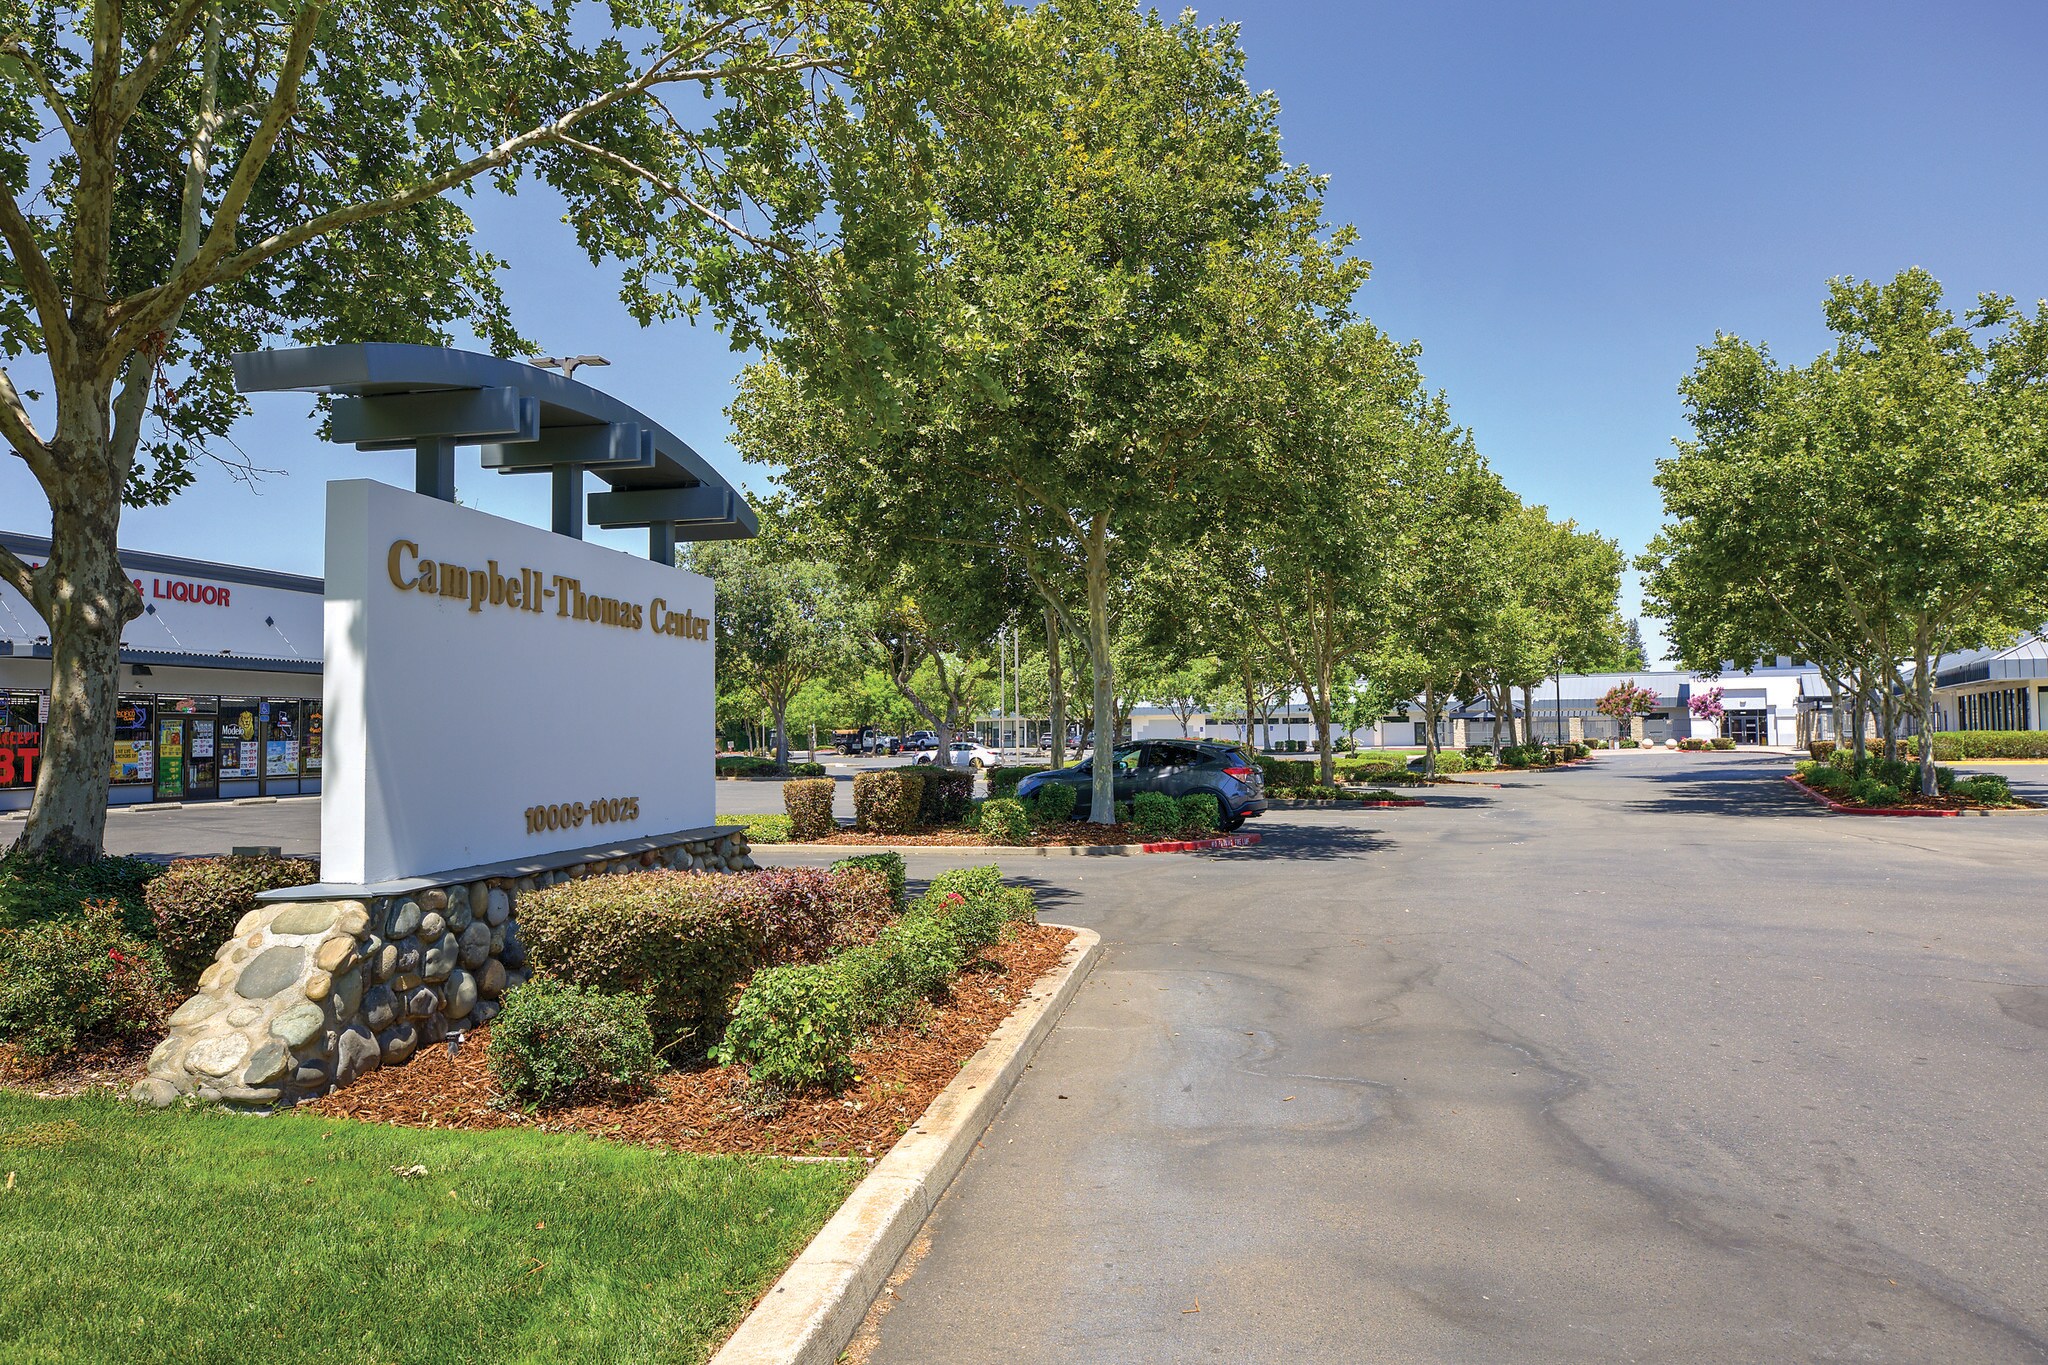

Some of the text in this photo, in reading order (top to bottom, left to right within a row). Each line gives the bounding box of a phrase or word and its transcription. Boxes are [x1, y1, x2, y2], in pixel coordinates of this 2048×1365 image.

[153, 578, 231, 607] LIQUOR
[388, 539, 711, 641] Campbell-Thomas Center
[0, 732, 39, 745] CCEPT
[222, 725, 245, 736] Modelo
[525, 797, 639, 834] 10009-10025
